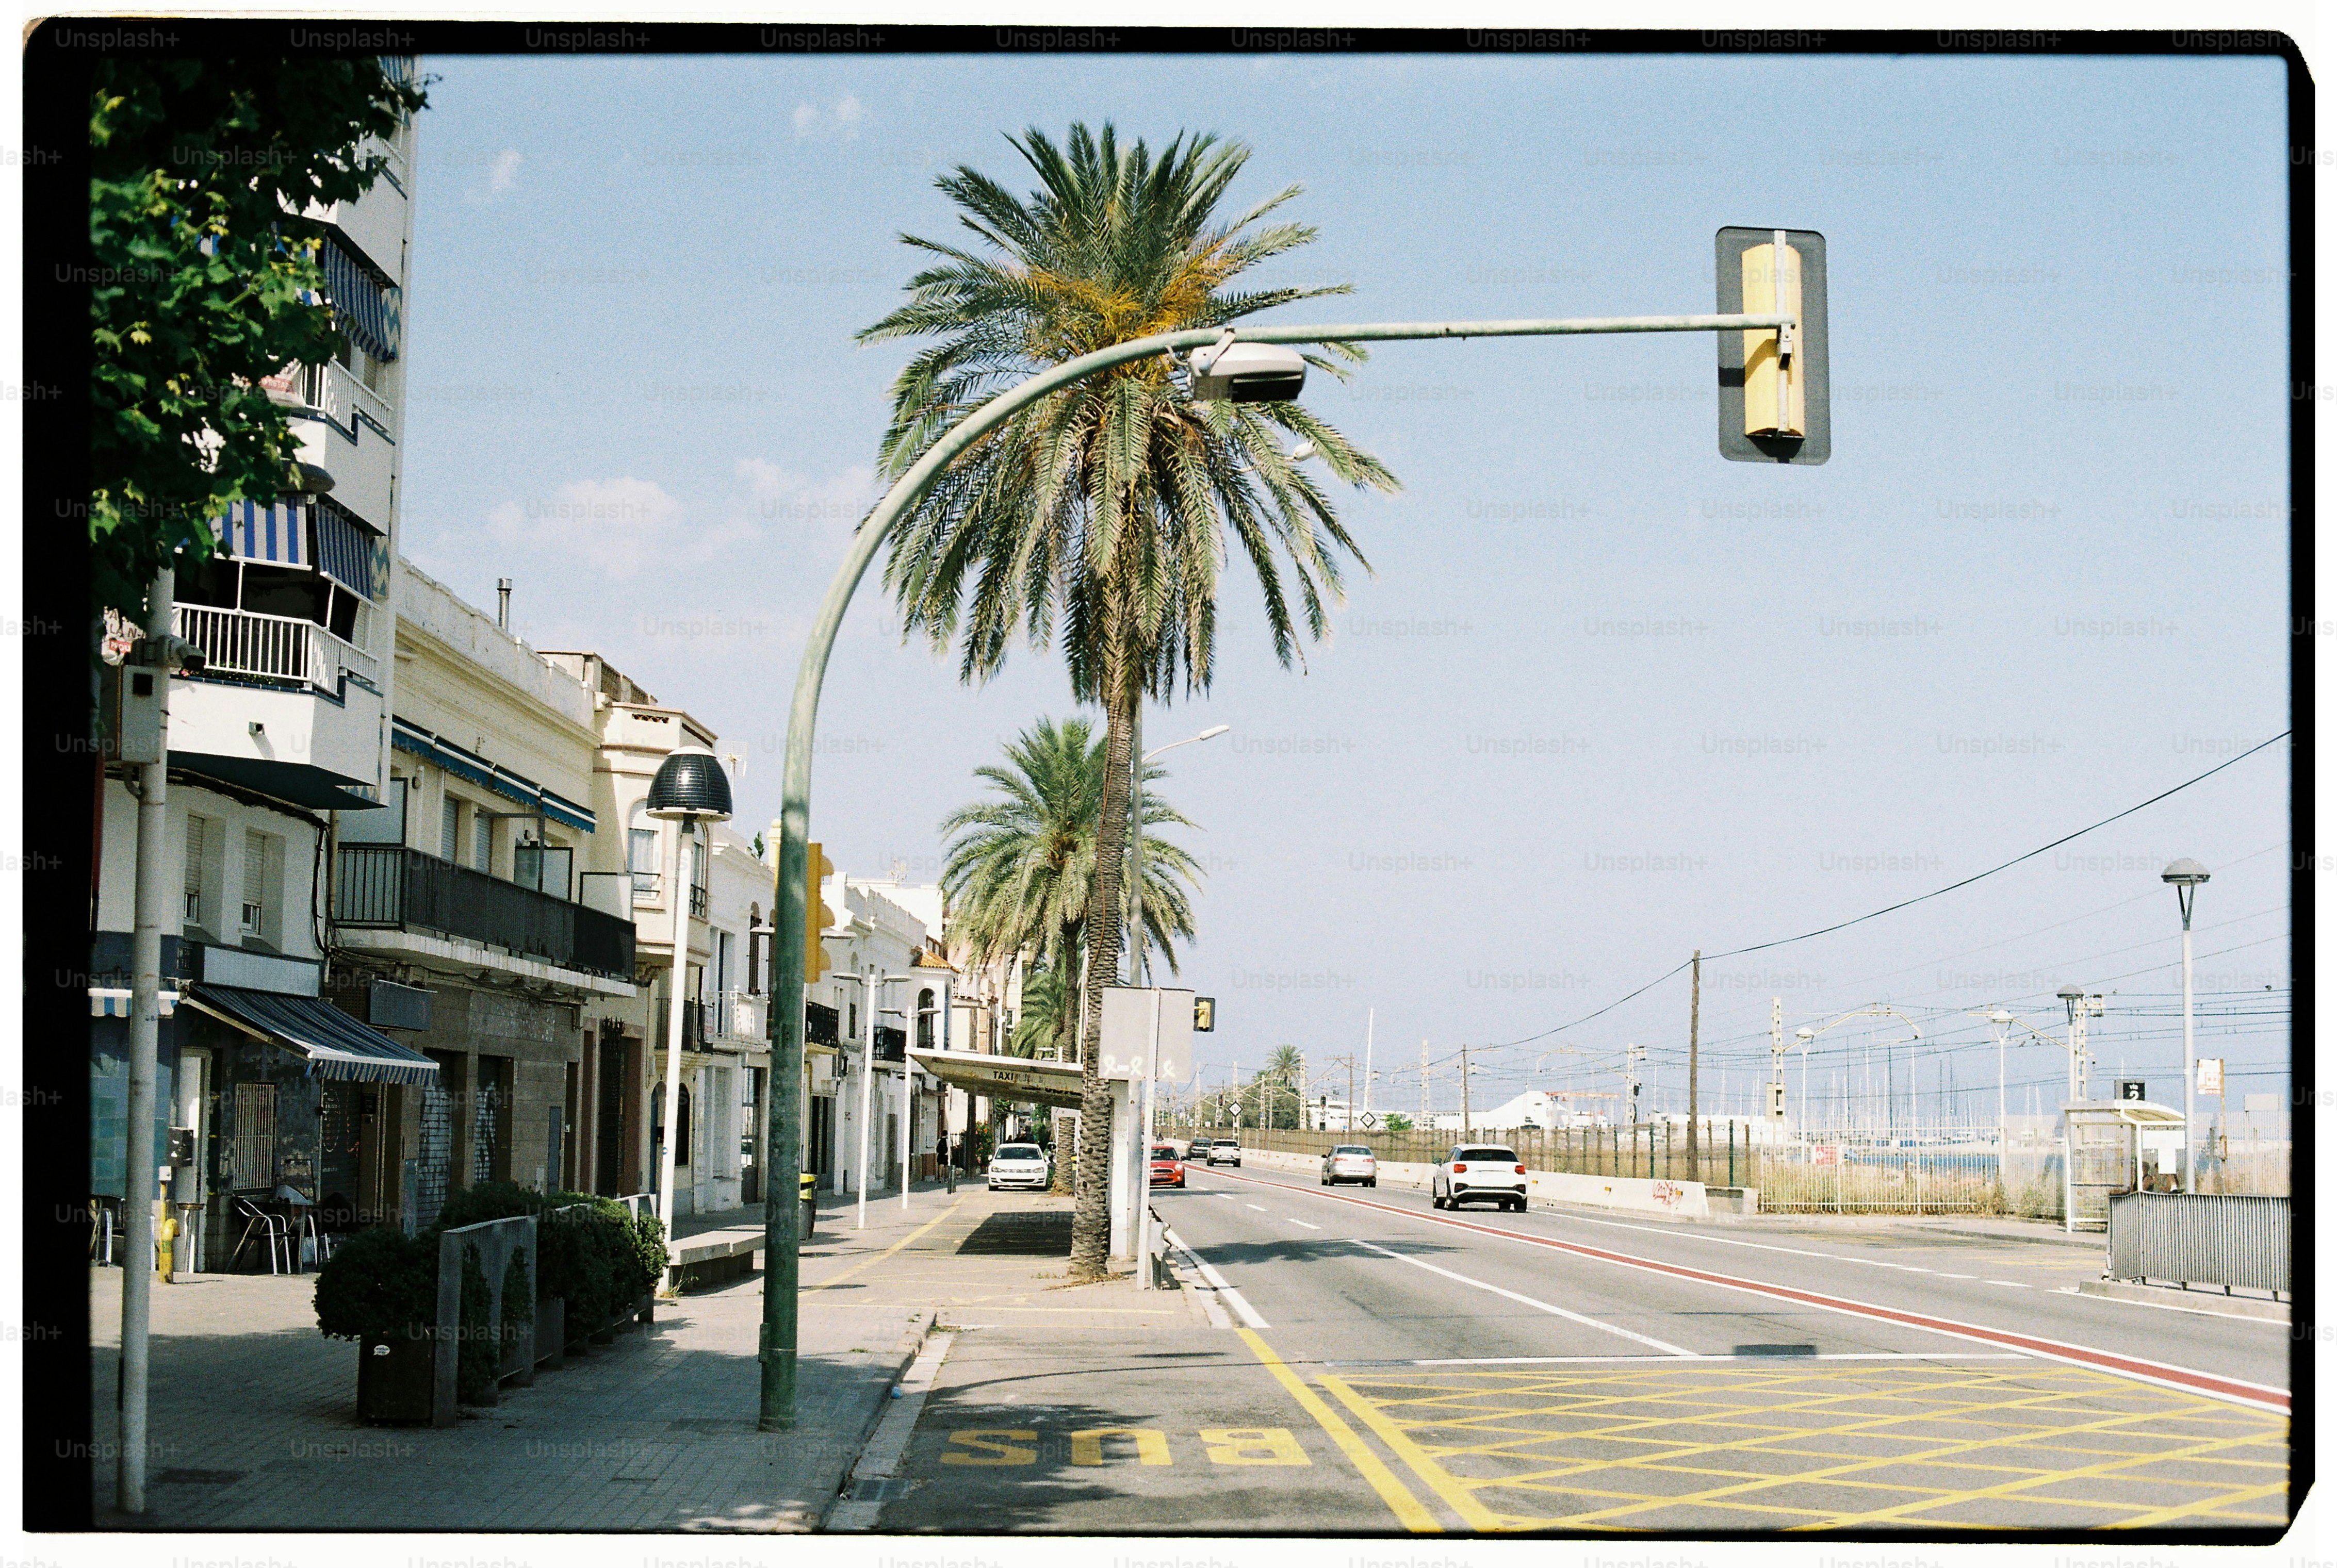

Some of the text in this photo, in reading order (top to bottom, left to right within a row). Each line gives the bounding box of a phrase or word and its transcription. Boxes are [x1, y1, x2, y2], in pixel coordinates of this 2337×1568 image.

[993, 1071, 1014, 1080] TAXI
[2129, 1090, 2139, 1100] 2
[940, 1428, 1312, 1465] BUS
